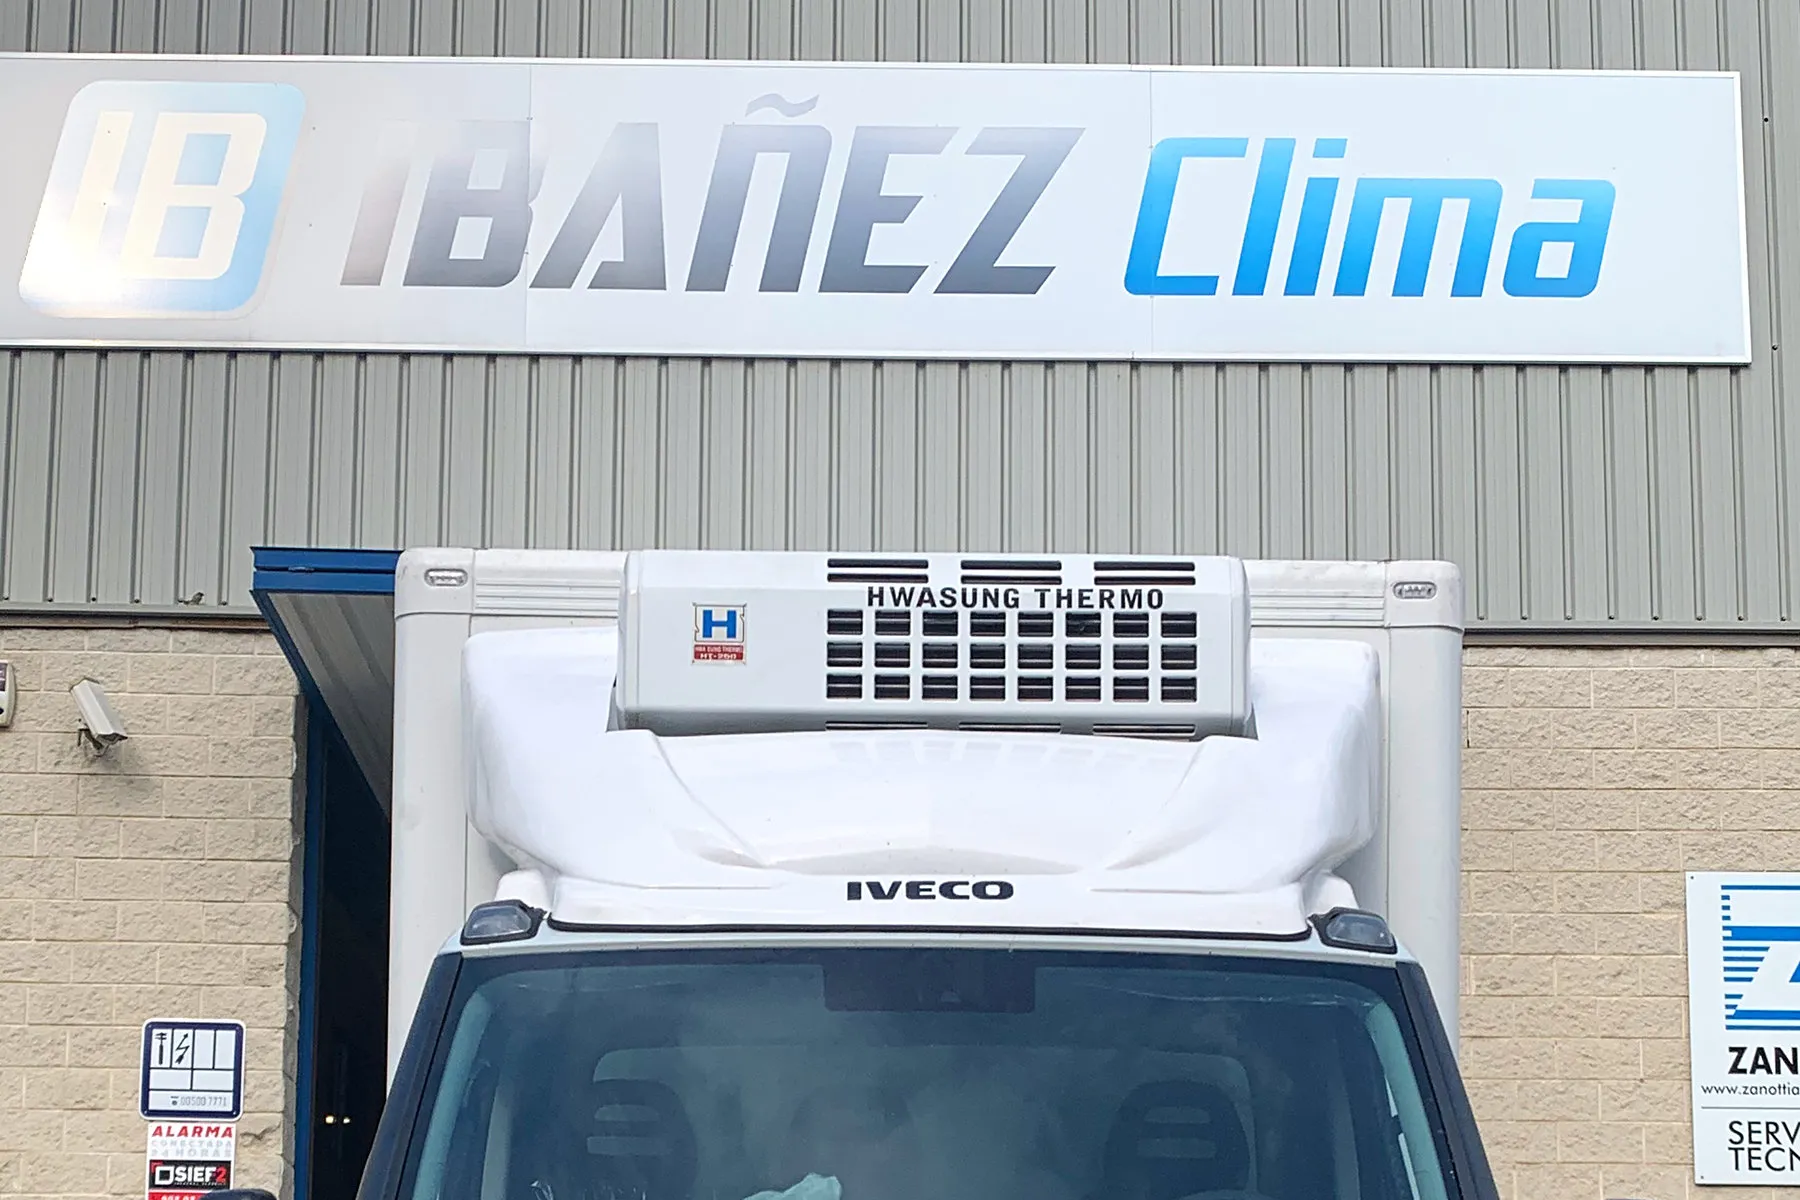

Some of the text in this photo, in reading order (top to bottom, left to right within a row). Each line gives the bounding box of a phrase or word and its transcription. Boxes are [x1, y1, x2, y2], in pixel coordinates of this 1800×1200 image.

[340, 93, 1616, 297] IBAÑEZ Clima
[867, 586, 1164, 609] HWASUNG THERMO
[847, 880, 1014, 900] IVECO
[1728, 1046, 1799, 1075] ZAN
[152, 1126, 233, 1138] ALARMA
[1728, 1120, 1800, 1145] SERV
